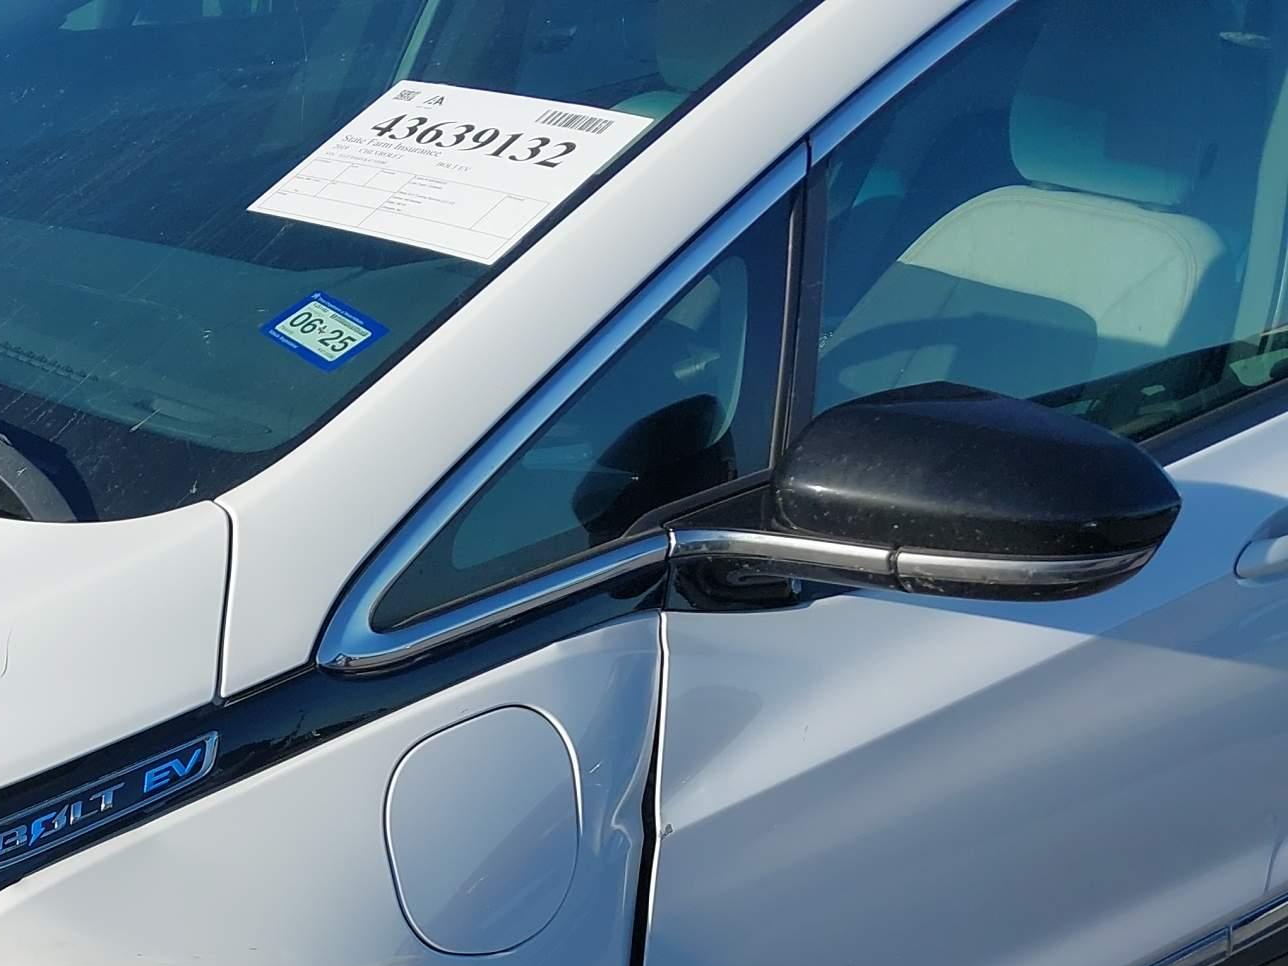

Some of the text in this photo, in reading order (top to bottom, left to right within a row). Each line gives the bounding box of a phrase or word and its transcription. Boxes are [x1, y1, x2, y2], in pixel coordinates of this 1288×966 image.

[342, 134, 442, 157] State Farm Insurance
[371, 113, 577, 168] 43639132
[289, 311, 324, 334] 06
[318, 329, 357, 353] 25
[143, 748, 201, 794] EV
